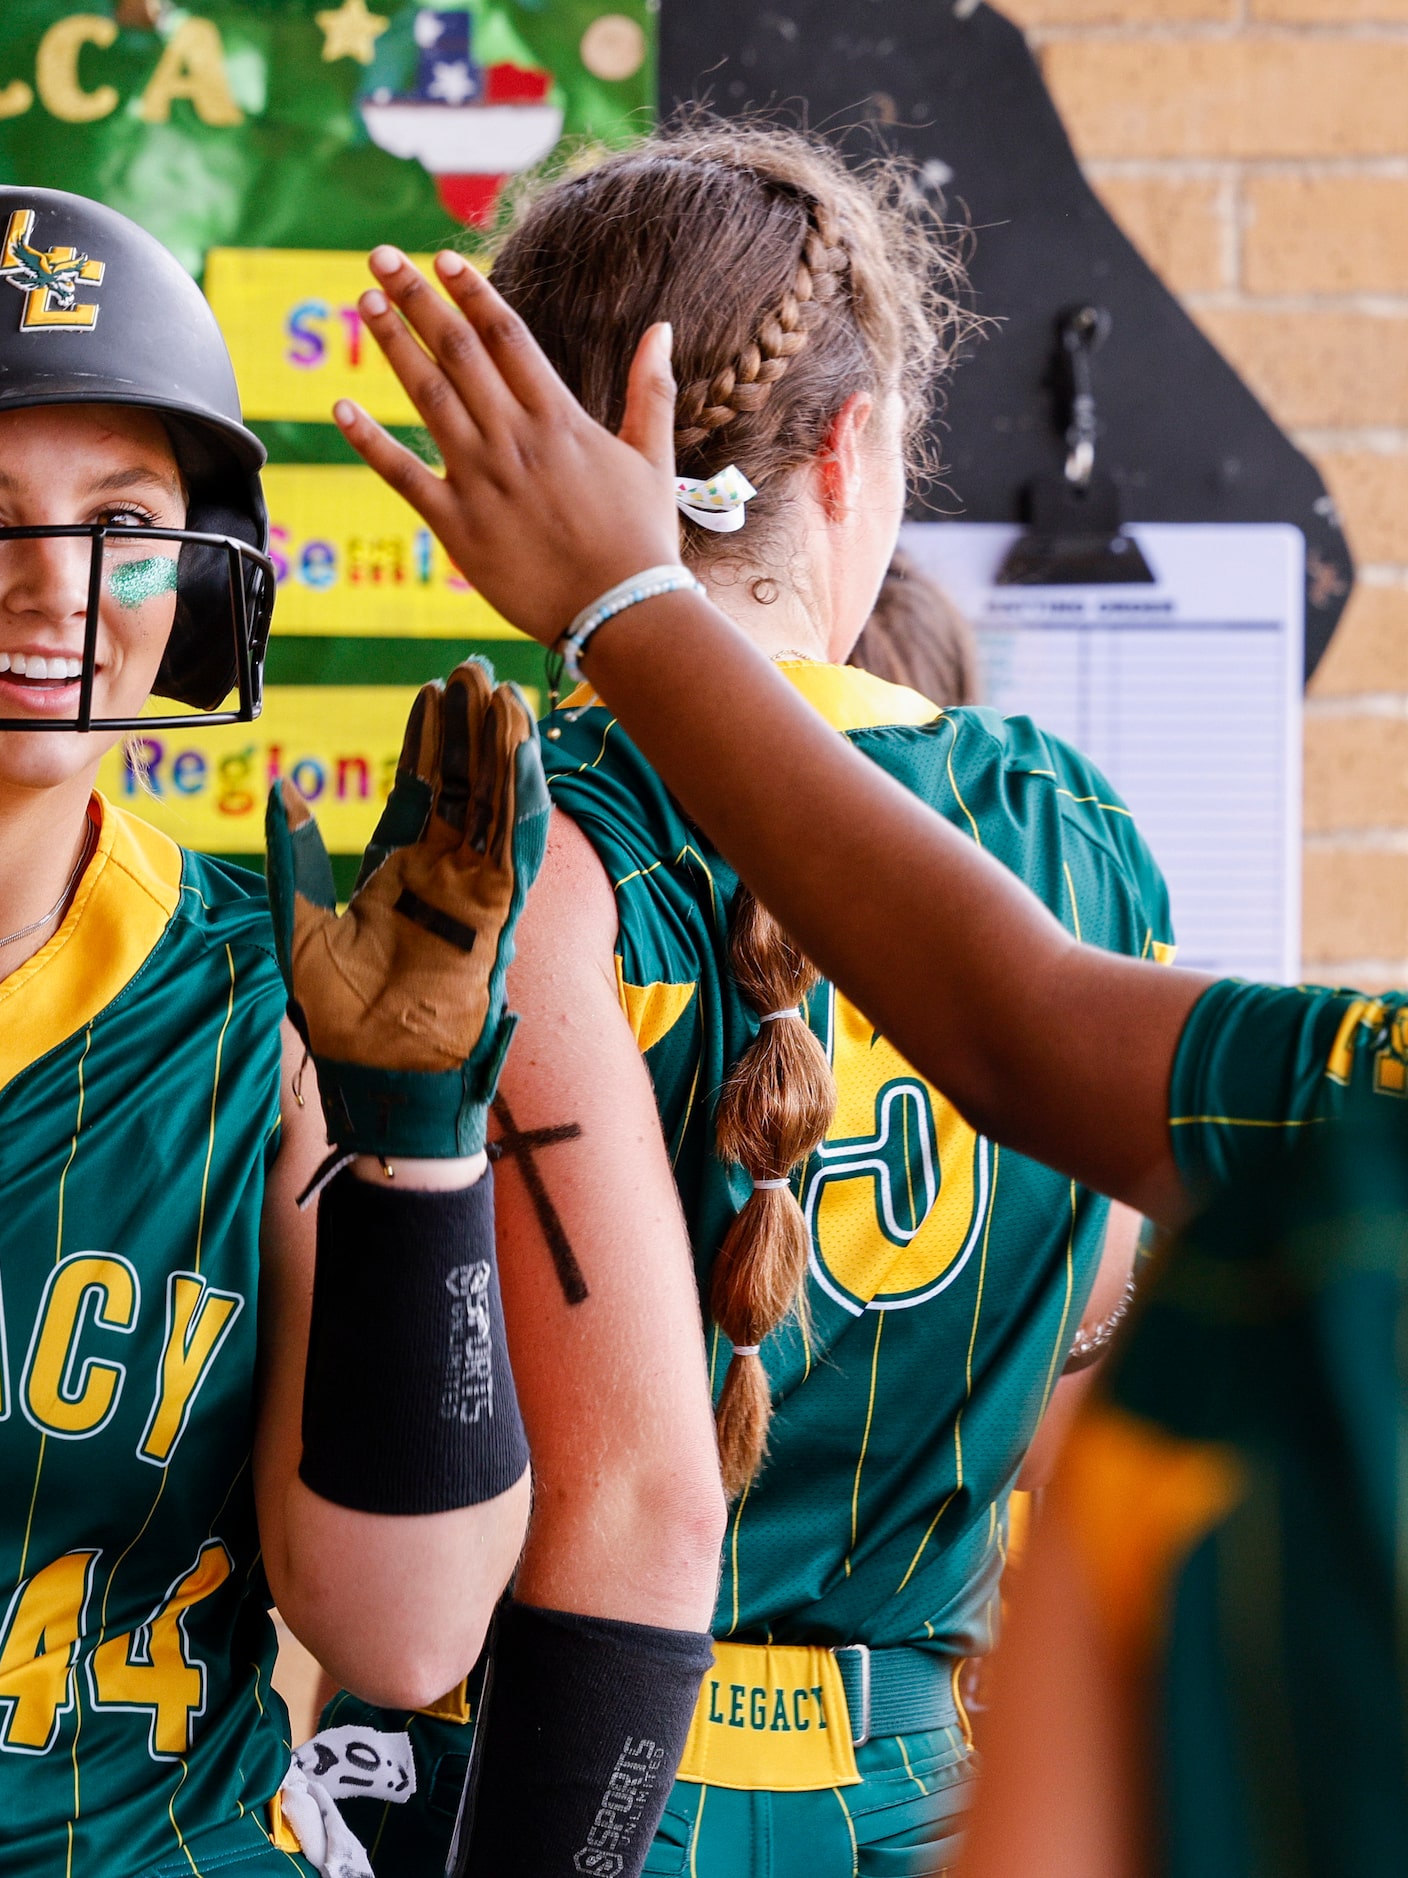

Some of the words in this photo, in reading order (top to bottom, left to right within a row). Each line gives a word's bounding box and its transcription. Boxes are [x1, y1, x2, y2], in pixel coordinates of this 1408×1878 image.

[285, 300, 362, 368] ST
[709, 1680, 828, 1732] LEGACY
[586, 1735, 656, 1850] SPORTS
[620, 1747, 664, 1846] UNLIMITED
